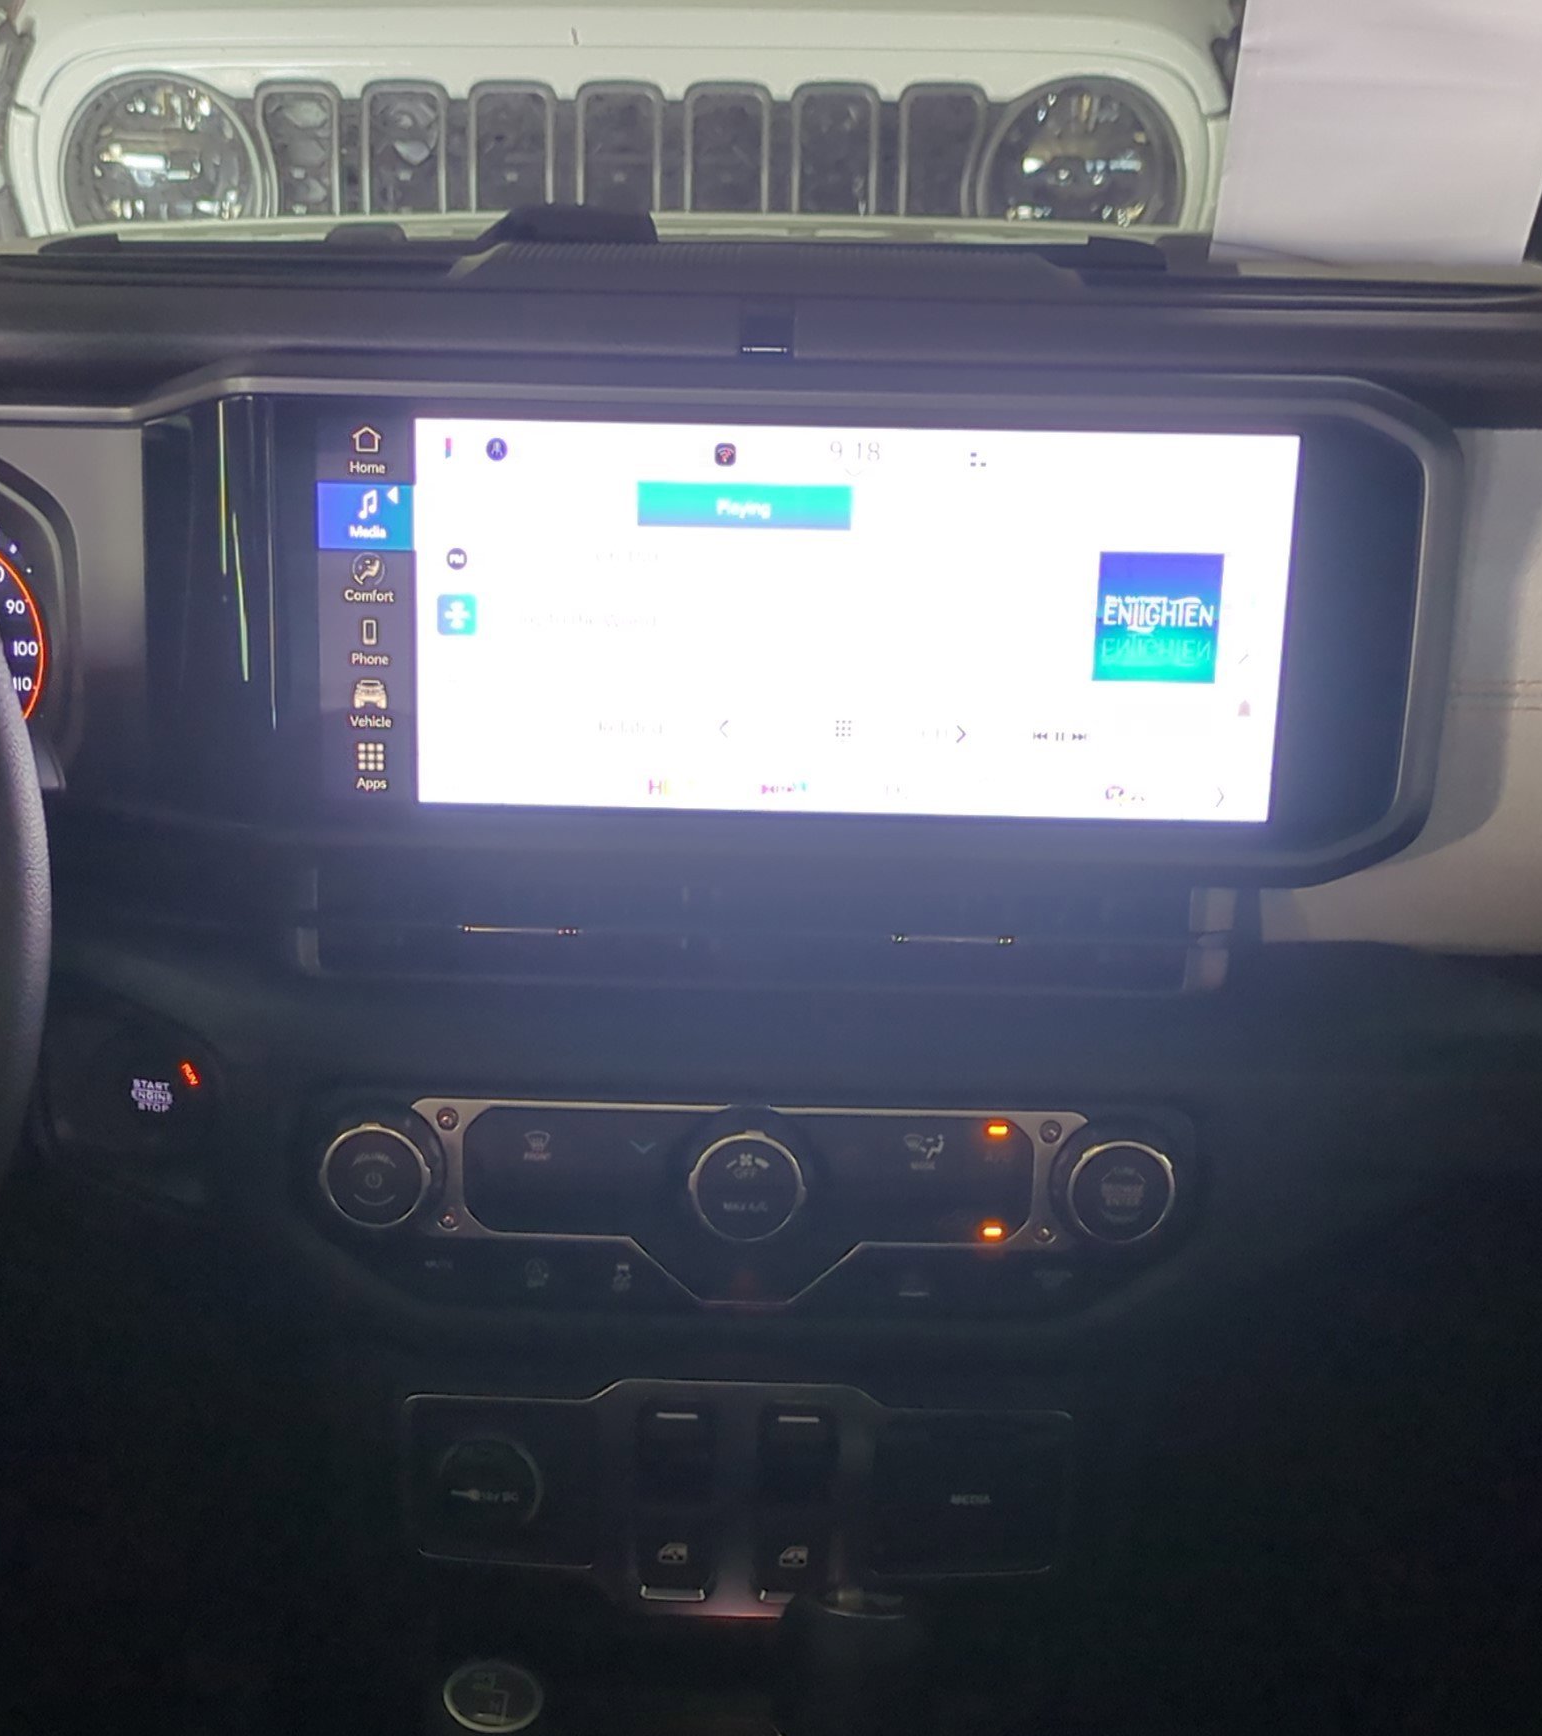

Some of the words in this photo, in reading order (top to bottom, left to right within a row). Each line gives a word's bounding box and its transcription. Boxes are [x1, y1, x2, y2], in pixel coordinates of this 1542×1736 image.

[349, 460, 386, 475] Home
[715, 497, 772, 519] Playing
[349, 524, 388, 540] Media
[344, 588, 395, 603] Comfort
[5, 599, 26, 615] 90
[12, 640, 39, 657] 100
[351, 652, 390, 666] Phone
[349, 713, 393, 729] Vehicle
[355, 776, 388, 791] Apps
